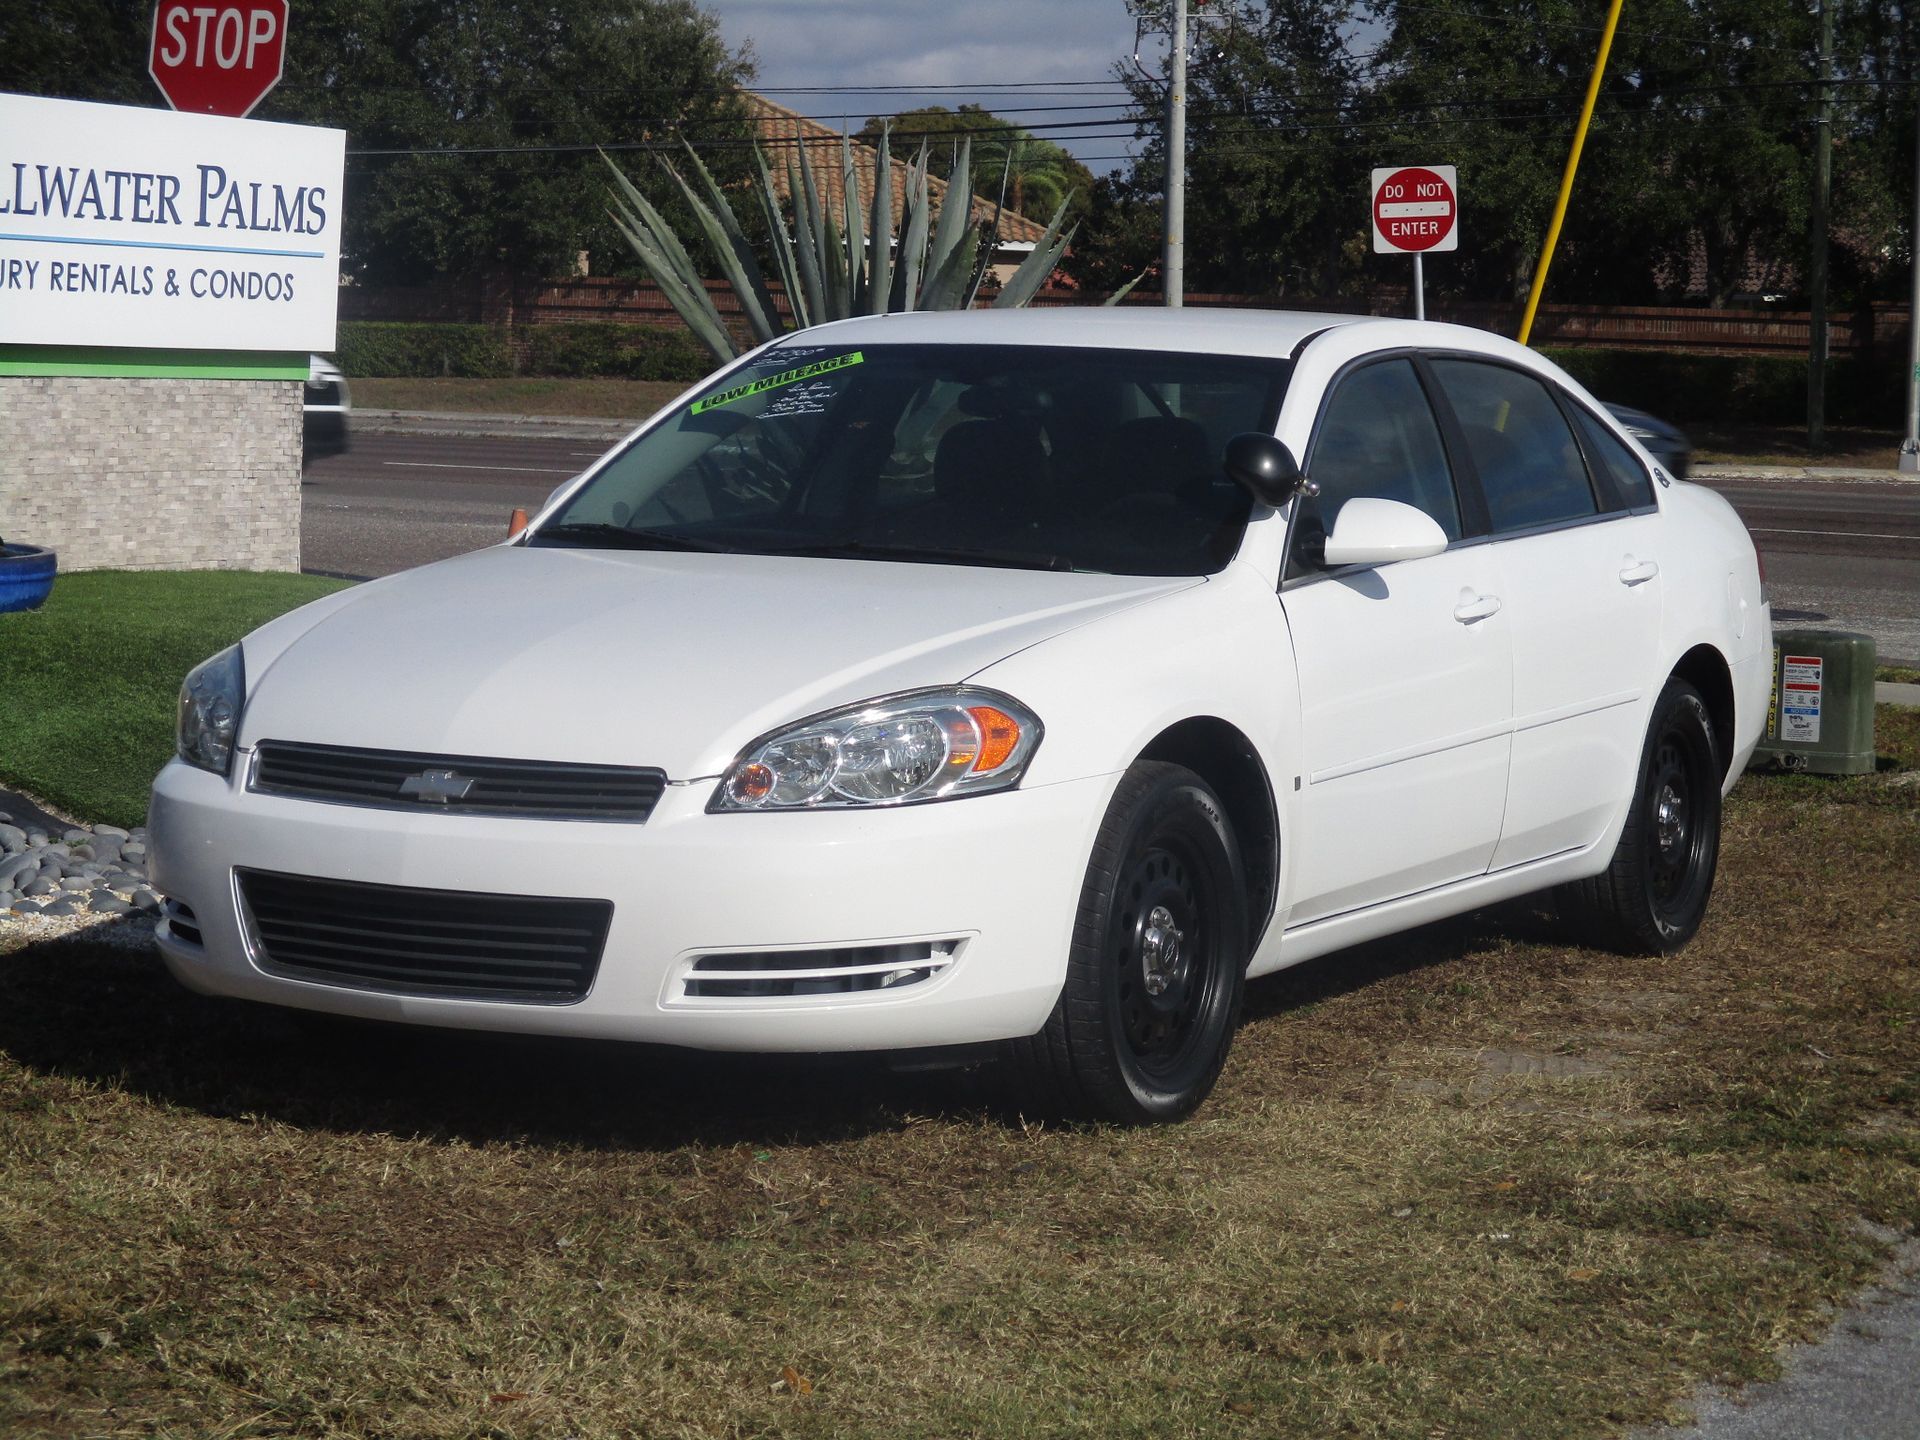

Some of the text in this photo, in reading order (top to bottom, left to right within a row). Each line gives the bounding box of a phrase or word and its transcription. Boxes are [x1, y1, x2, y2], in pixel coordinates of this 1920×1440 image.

[161, 6, 277, 70] STOP
[194, 164, 327, 235] PALMS
[1385, 183, 1443, 198] DO NOT
[1391, 221, 1438, 236] ENTER
[50, 261, 154, 296] RENTALS
[164, 268, 180, 297] &
[190, 268, 295, 302] CONDOS
[700, 383, 750, 410] LOW
[753, 354, 856, 391] MILEAGE
